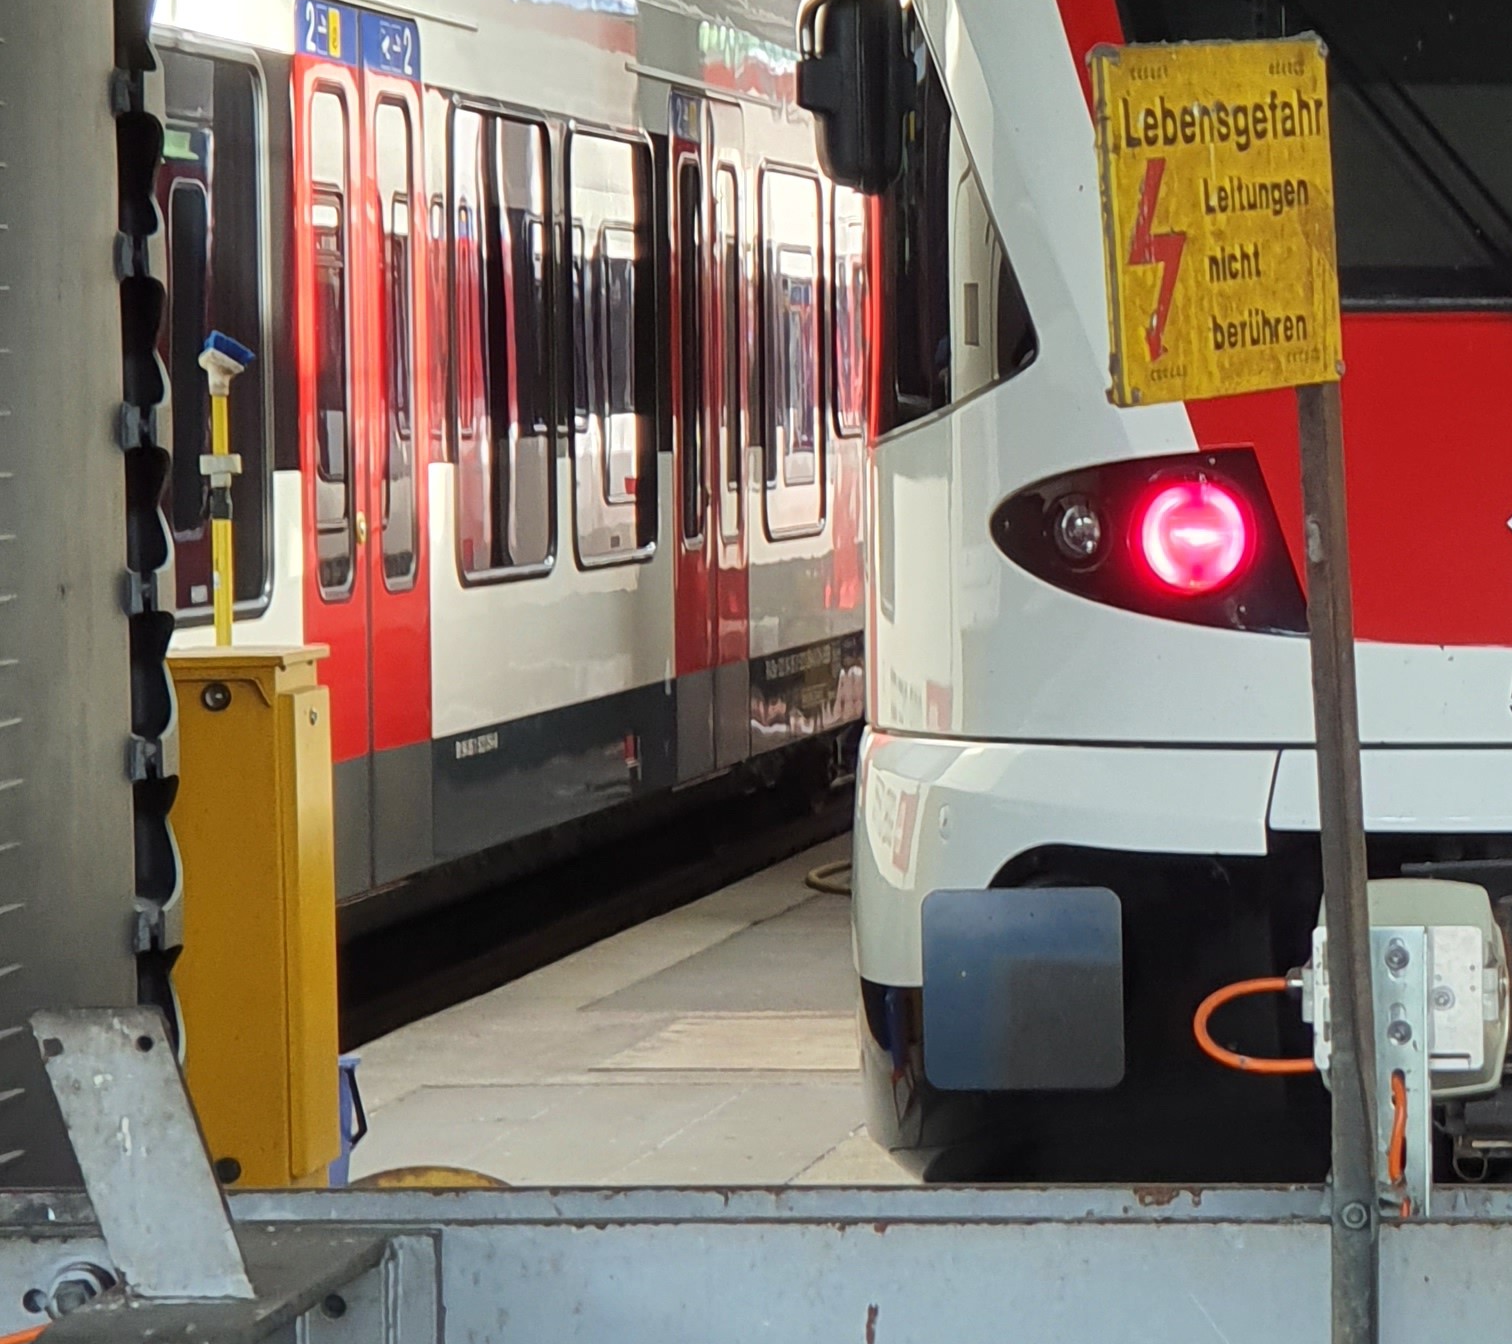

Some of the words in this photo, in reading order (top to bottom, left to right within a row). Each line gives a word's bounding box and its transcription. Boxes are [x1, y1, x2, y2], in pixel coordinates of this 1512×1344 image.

[305, 0, 317, 53] 2
[403, 26, 413, 76] 2
[1121, 90, 1323, 152] Lebensgefahr
[1203, 177, 1309, 216] Leitungen
[1208, 242, 1261, 284] nicht
[1211, 308, 1308, 351] berühren
